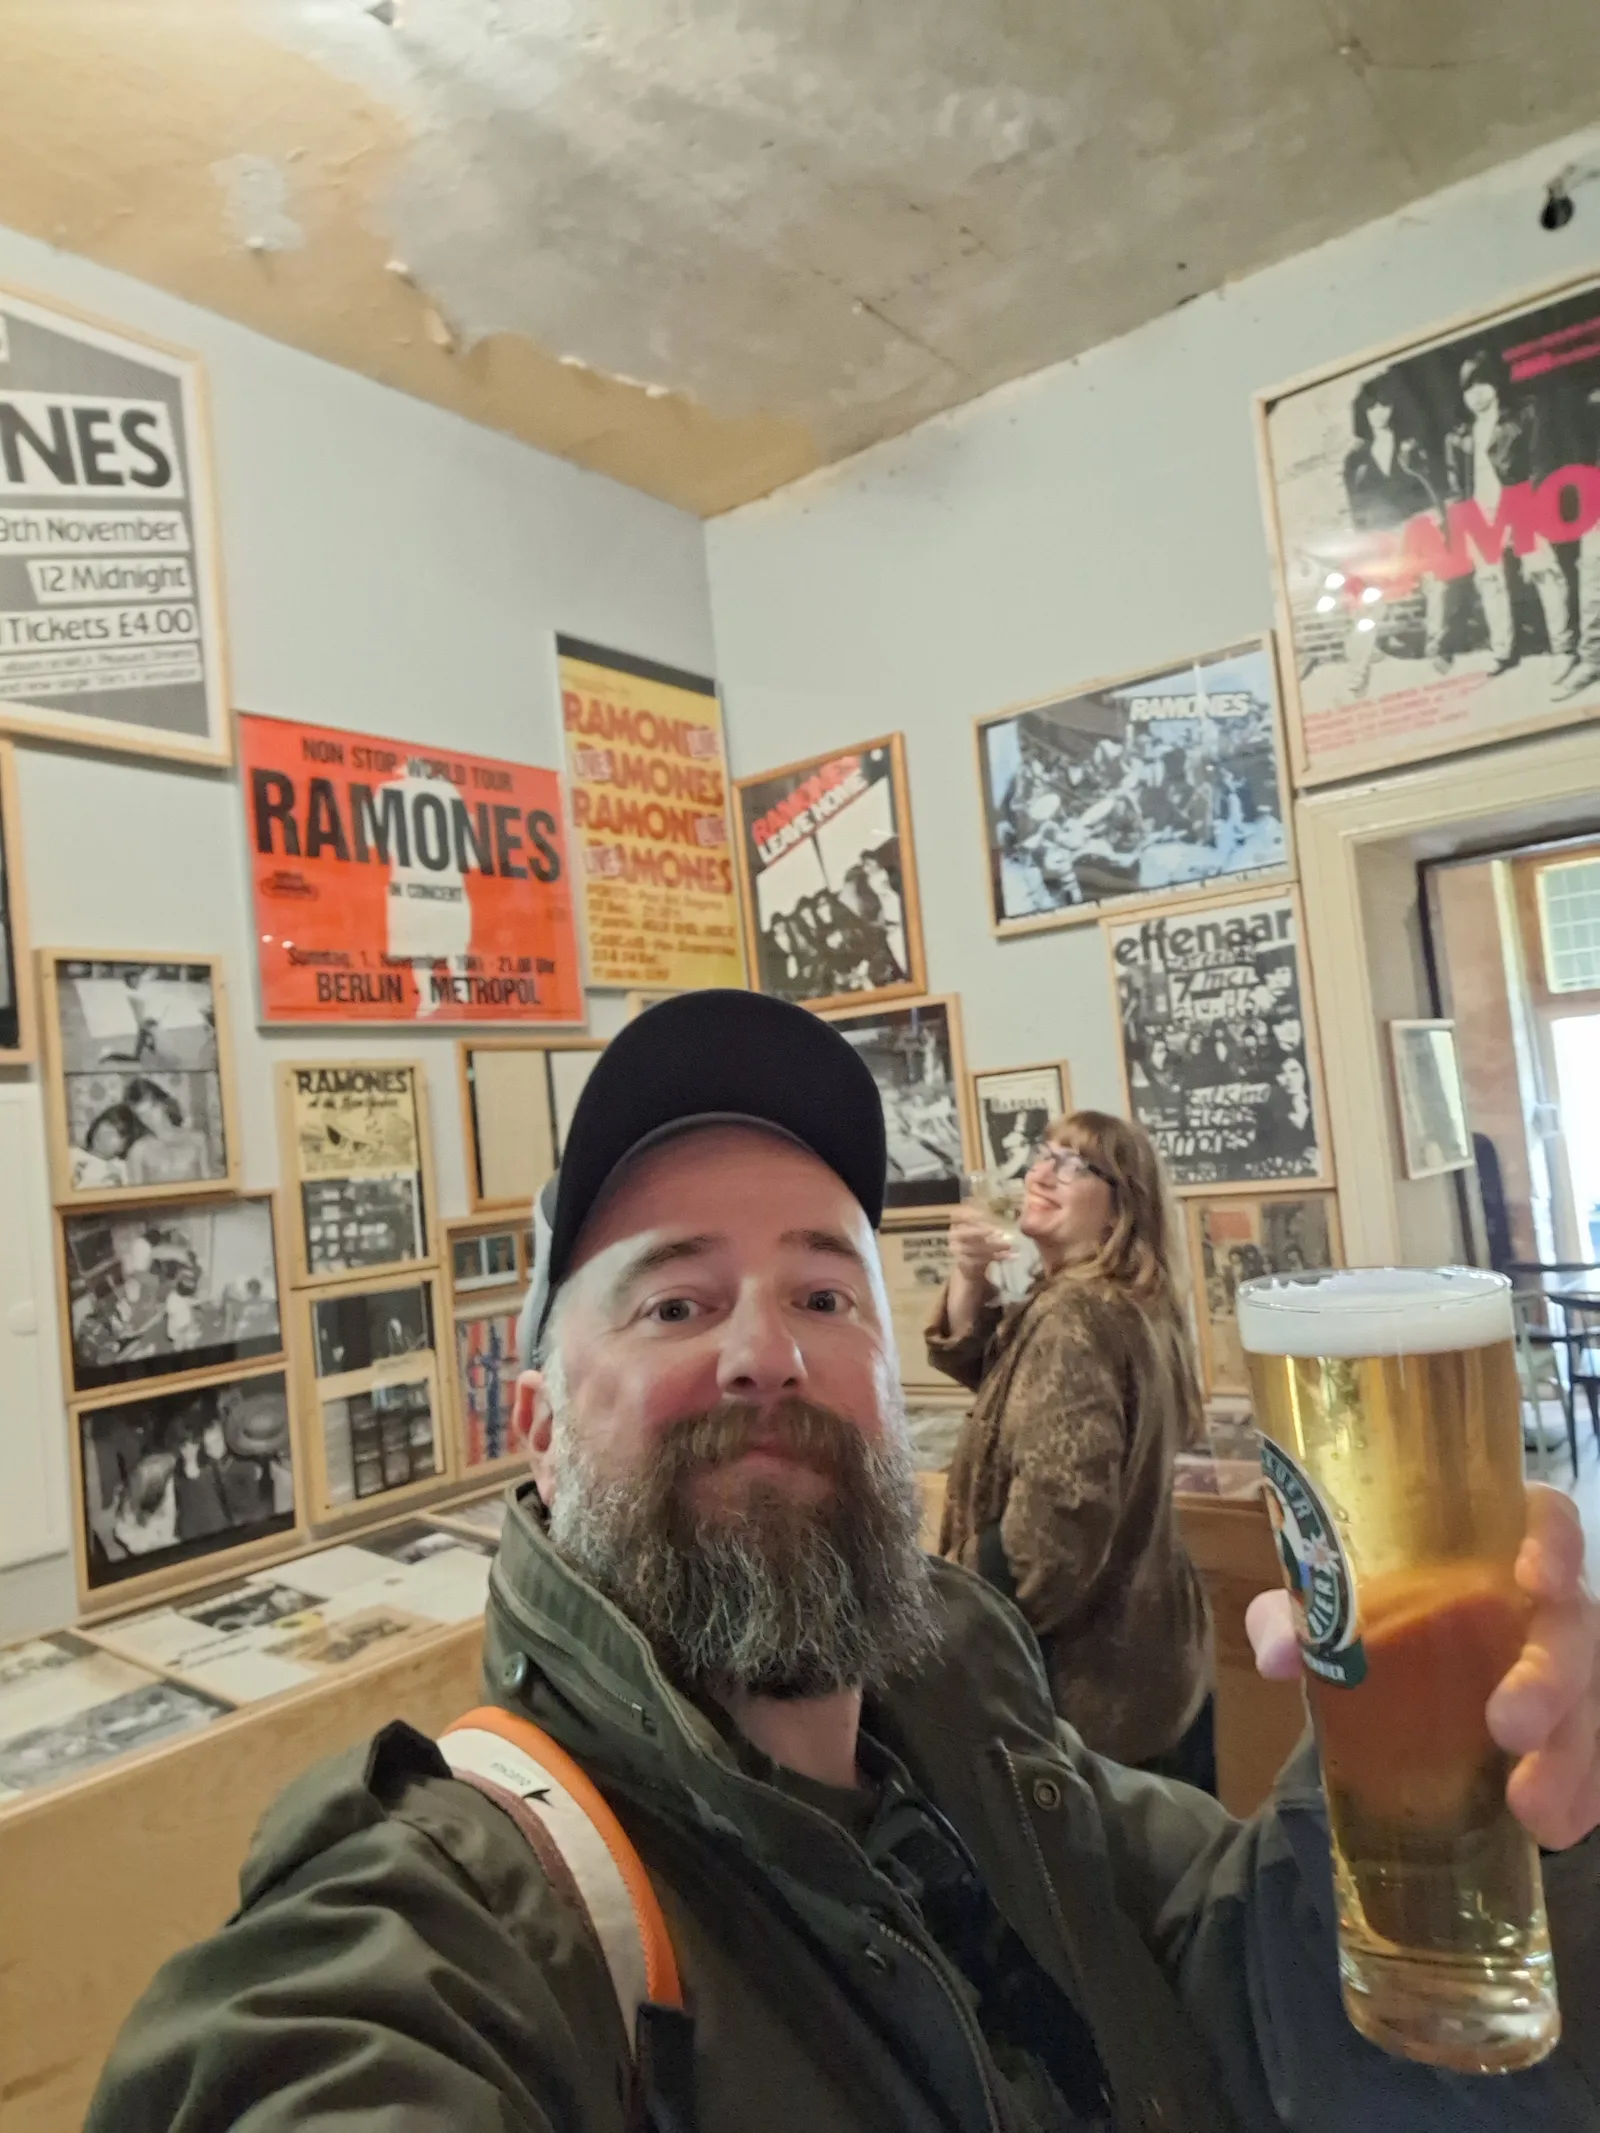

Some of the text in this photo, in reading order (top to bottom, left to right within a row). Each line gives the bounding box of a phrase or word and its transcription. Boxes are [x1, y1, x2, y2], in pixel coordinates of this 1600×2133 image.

[46, 516, 179, 543] November
[39, 562, 187, 594] 12 Midnight
[8, 614, 109, 643] Tickets
[1129, 692, 1249, 721] RAMONES
[563, 691, 717, 757] RAMONE
[303, 738, 513, 793] NON STOP WORLD TOUR
[251, 767, 561, 884] RAMONES
[572, 787, 725, 848] RAMONE
[1114, 908, 1292, 966] effenaar
[316, 972, 405, 1003] BERLIN
[430, 976, 541, 1006] METROPOL
[297, 1068, 407, 1095] RAMONES
